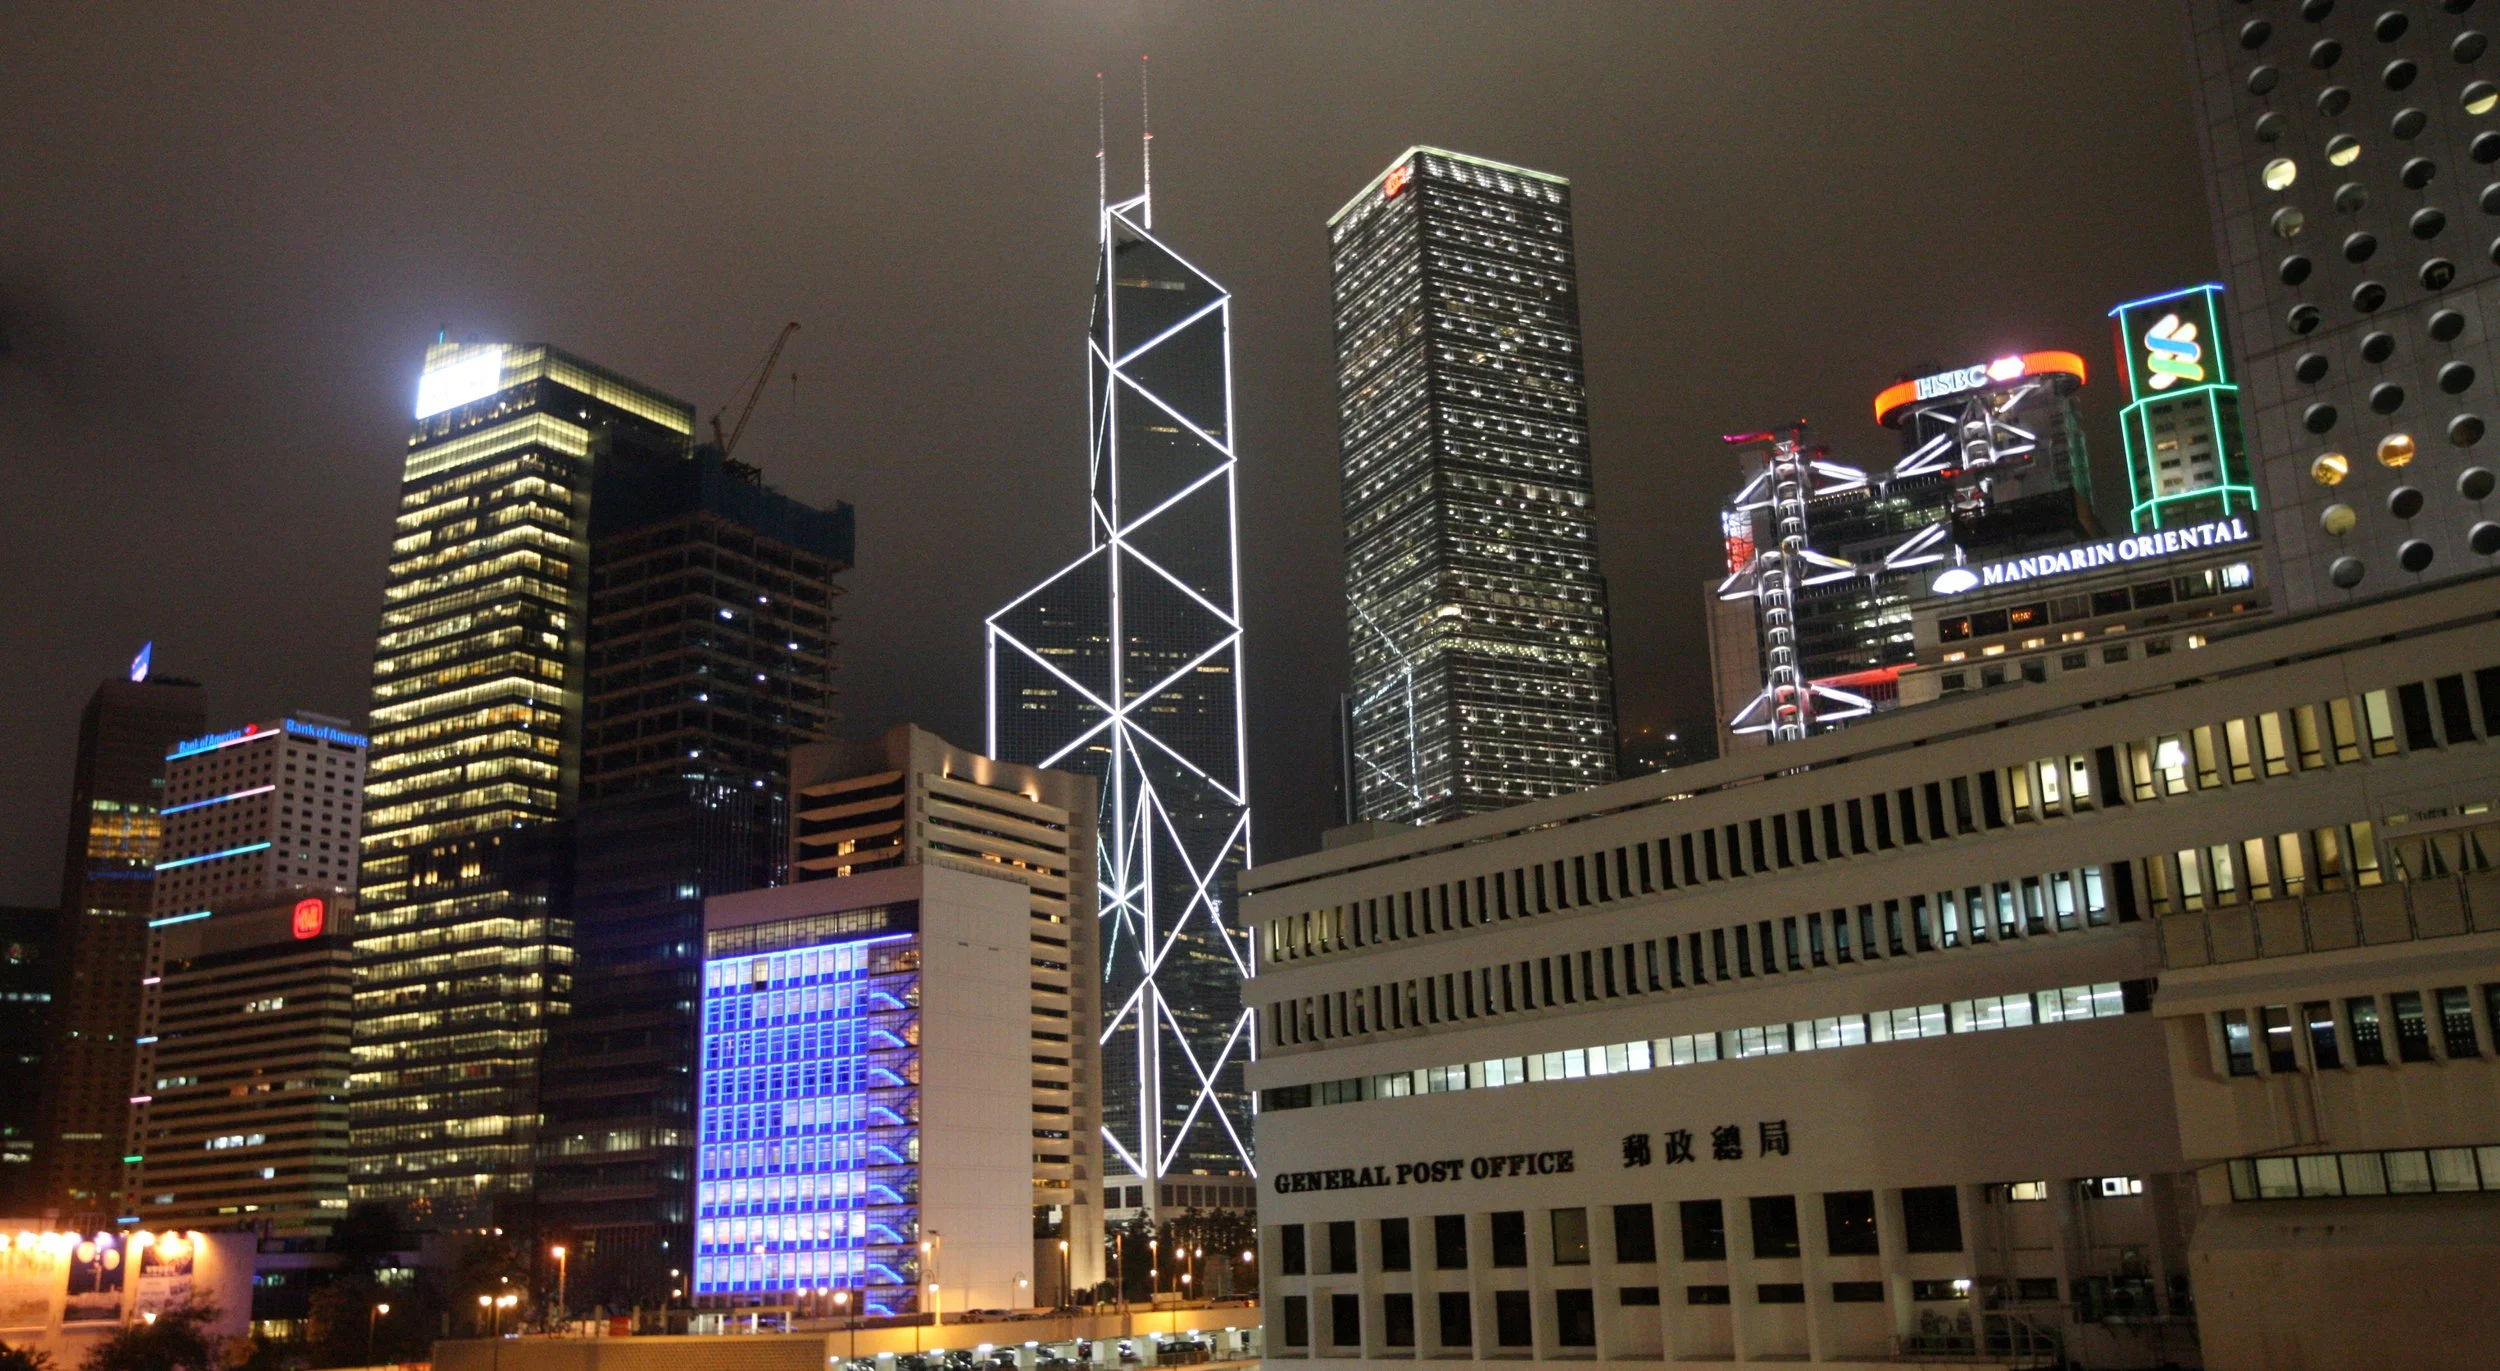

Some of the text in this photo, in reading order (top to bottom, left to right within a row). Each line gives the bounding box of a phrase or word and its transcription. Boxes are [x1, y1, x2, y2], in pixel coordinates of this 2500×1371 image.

[1917, 364, 1988, 400] HSBC
[1982, 518, 2248, 586] MANDARIN ORIENTAL
[178, 738, 199, 753] Bank
[209, 729, 242, 746] America
[286, 717, 368, 747] Bank of Americ
[1622, 1119, 1790, 1168] 郵政總局
[1274, 1150, 1575, 1194] GENERAL POST OFFICE
